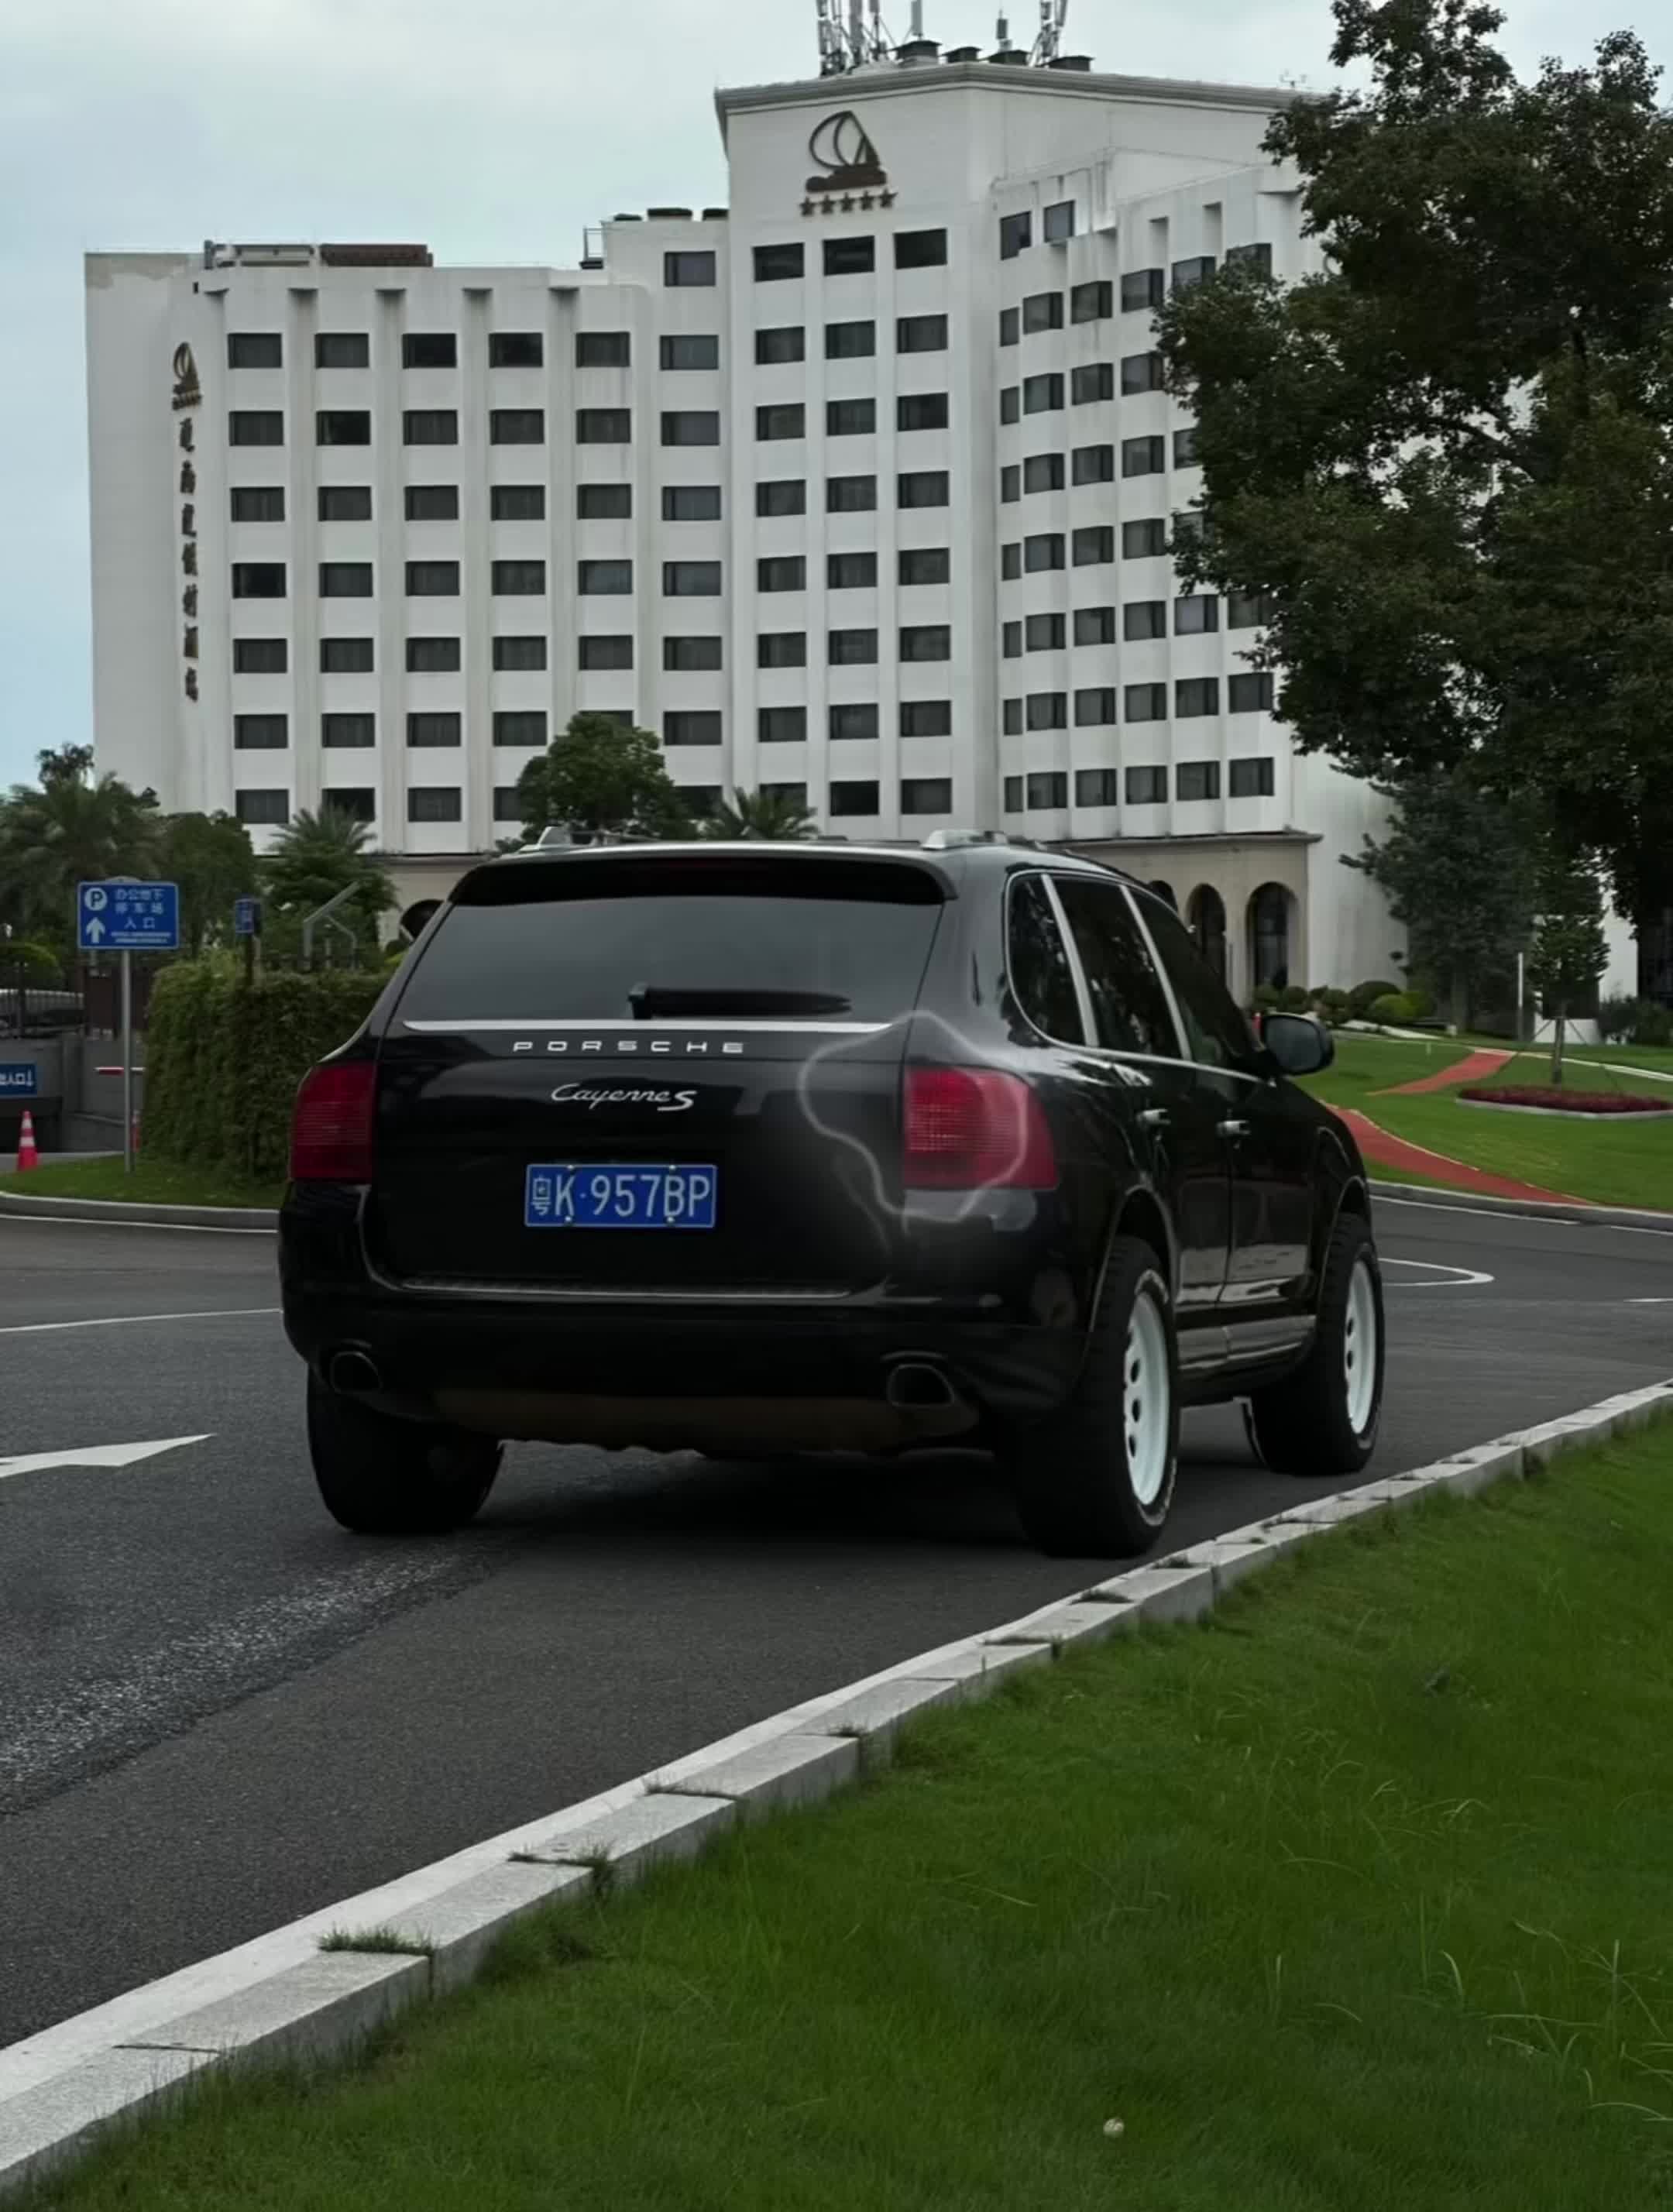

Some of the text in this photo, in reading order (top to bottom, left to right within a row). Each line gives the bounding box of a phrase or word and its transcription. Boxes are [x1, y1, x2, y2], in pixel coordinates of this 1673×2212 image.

[124, 917, 156, 929] 入口
[513, 1040, 744, 1053] PORSCHE
[551, 1083, 698, 1111] Cayenne S
